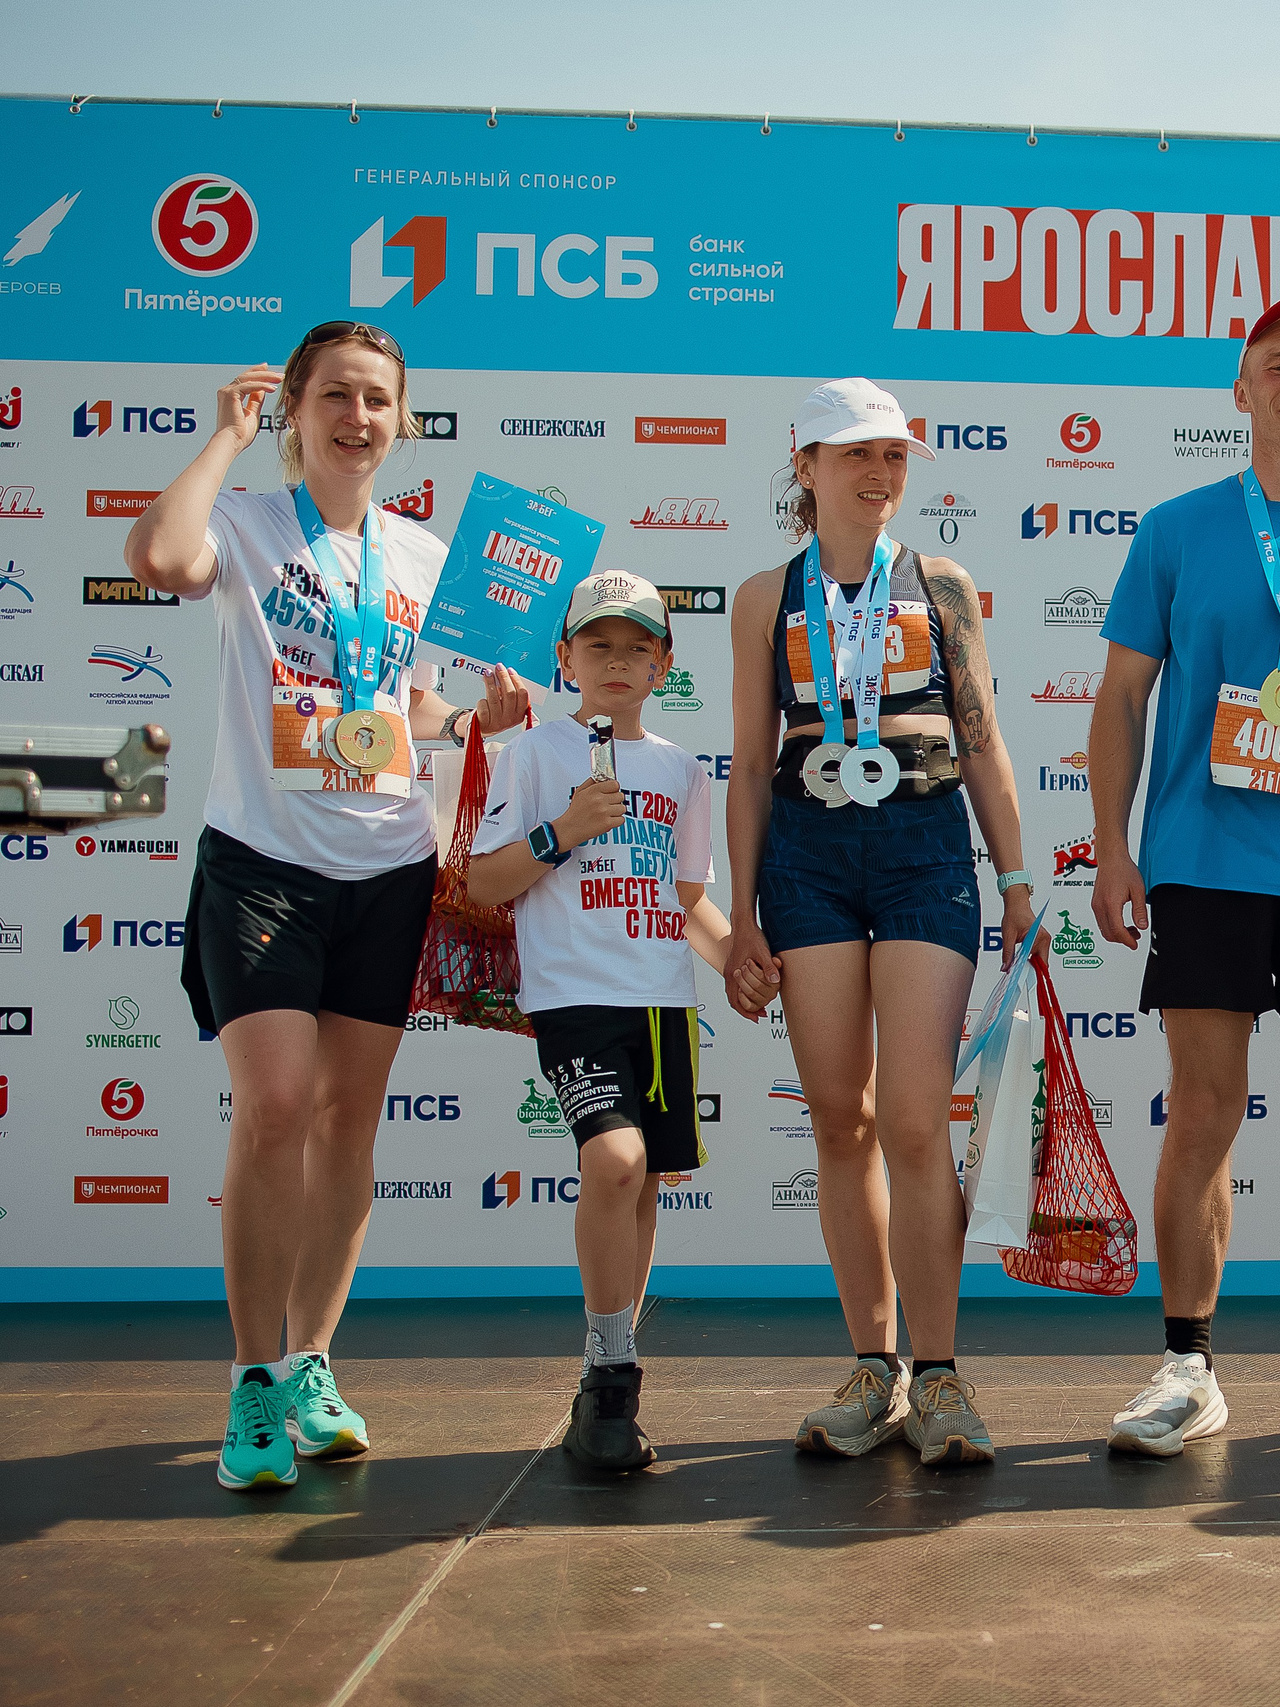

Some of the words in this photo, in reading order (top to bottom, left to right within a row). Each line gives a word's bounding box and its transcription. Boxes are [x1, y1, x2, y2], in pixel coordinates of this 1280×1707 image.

[354, 167, 512, 188] ГЕНЕРАЛЬНЫЙ
[519, 172, 618, 191] СПОНСОР
[180, 186, 236, 257] 5
[688, 233, 746, 254] банк
[476, 231, 660, 300] ПСБ
[688, 260, 785, 280] сильной
[0, 280, 62, 296] ЕРОЕВ
[688, 285, 775, 306] страны
[124, 287, 284, 317] Пятёрочка
[122, 407, 197, 434] ПСБ
[500, 418, 607, 438] СЕНЕЖСКАЯ
[656, 425, 720, 436] ЧЕМПИОНАТ
[936, 424, 1008, 451] ПСБ
[1173, 428, 1250, 444] HUAWEI
[1174, 446, 1218, 458] WATCH
[1221, 447, 1238, 458] FIT
[1241, 448, 1250, 458] 4
[1046, 458, 1115, 471] Пятёрочка
[109, 498, 153, 508] ЧЕМПИО
[929, 508, 977, 518] БАЛТИКА
[938, 518, 959, 544] 0
[1068, 510, 1139, 535] ПСБ
[491, 534, 564, 585] МЕСТО
[1262, 540, 1275, 564] ПСБ
[807, 557, 815, 580] ПСБ
[1047, 606, 1090, 618] AHMAD
[848, 617, 861, 642] ПСБ
[871, 619, 882, 640] ПСБ
[366, 646, 376, 668] ПСБ
[821, 676, 829, 698] ПСБ
[1240, 692, 1258, 703] ПСБ
[677, 701, 699, 709] ОСНОВА
[1039, 766, 1090, 792] ГЕРКУ
[0, 834, 49, 860] СБ
[100, 839, 179, 853] YAMAGUCHI
[580, 877, 660, 910] ВМЕСТЕ
[113, 920, 186, 946] ПСБ
[625, 909, 640, 939] С
[1053, 938, 1095, 951] bionova
[405, 1013, 448, 1032] зен
[1067, 1012, 1137, 1038] ПСБ
[85, 1034, 161, 1048] SYNERGETIC
[571, 1080, 592, 1096] YOUR
[386, 1094, 462, 1121] ПСБ
[516, 1107, 562, 1120] bionova
[577, 1099, 616, 1119] ENERGY
[86, 1126, 159, 1139] Пятёрочка
[97, 1185, 162, 1194] ЧЕМПИОНАТ
[531, 1176, 581, 1203] ПС
[657, 1191, 713, 1210] РКУЛЕС
